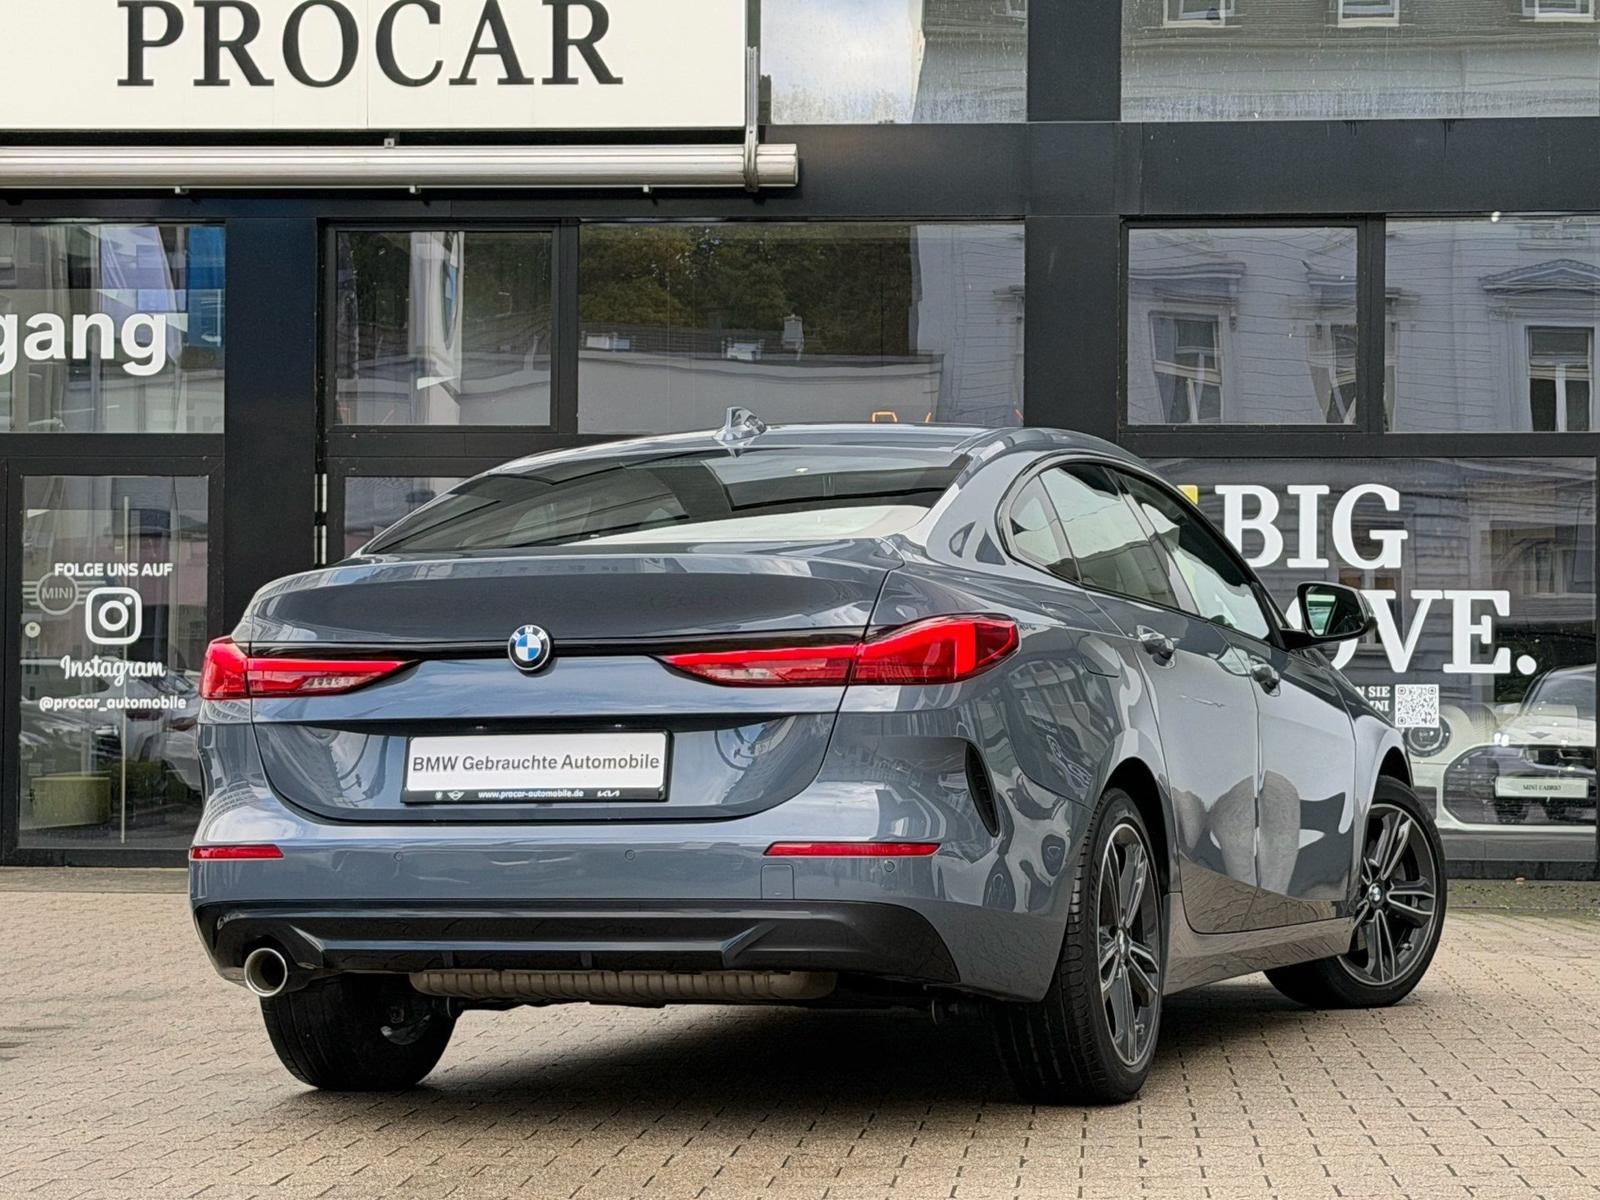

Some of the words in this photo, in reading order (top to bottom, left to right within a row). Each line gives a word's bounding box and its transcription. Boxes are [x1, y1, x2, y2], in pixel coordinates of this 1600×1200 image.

[117, 0, 624, 88] PROCAR
[1214, 483, 1409, 570] BIG
[54, 562, 104, 577] FOLGE
[106, 562, 139, 577] UNS
[141, 562, 174, 577] AUF
[41, 587, 74, 600] MINI
[60, 654, 167, 687] Instagram
[1368, 685, 1391, 698] SIE
[39, 696, 187, 712] @procar_automobile
[412, 756, 459, 772] BMW
[462, 754, 558, 771] Gebrauchte
[560, 753, 660, 769] Automobile
[477, 788, 584, 800] www.procar-automobile.de
